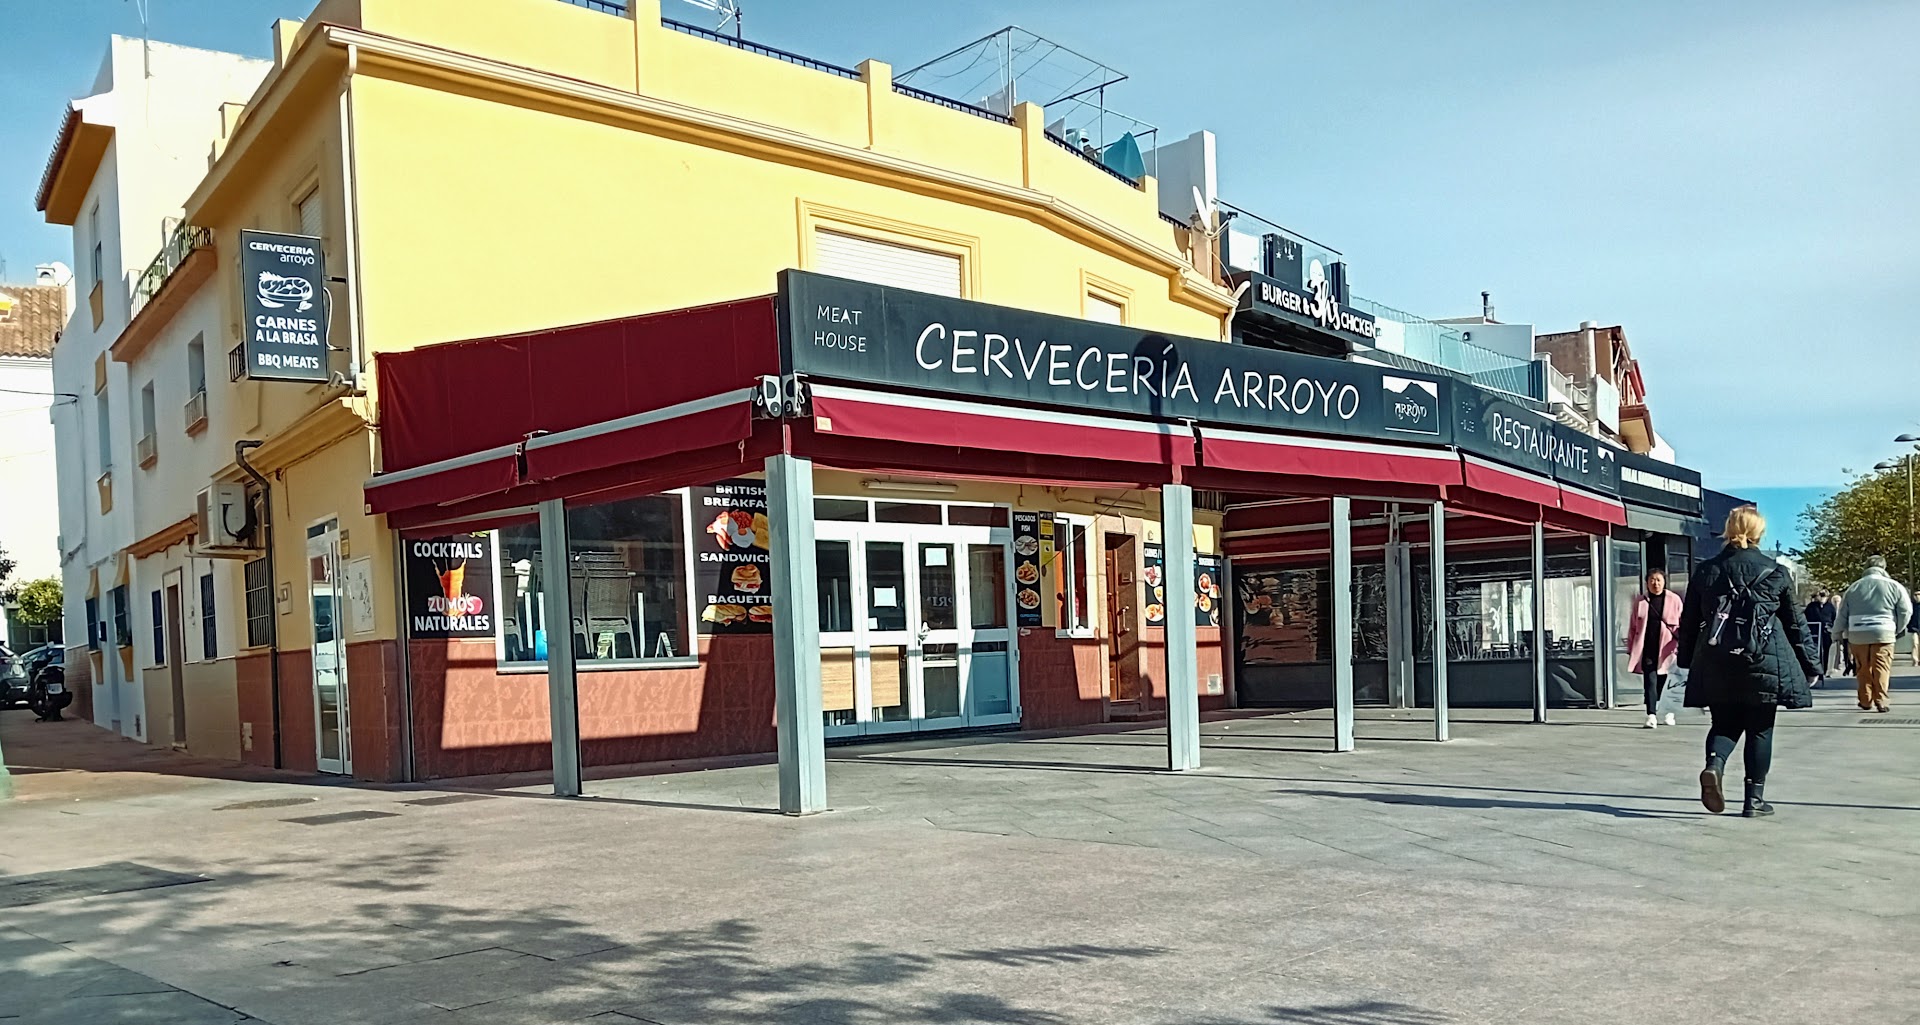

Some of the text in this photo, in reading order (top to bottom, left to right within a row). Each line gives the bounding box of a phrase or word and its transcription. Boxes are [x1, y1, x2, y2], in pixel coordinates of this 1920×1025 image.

[249, 241, 315, 256] CERVECERIA
[279, 253, 315, 267] arroyo
[816, 305, 862, 326] MEAT
[1262, 282, 1302, 313] BURGER
[1303, 297, 1311, 316] &
[1341, 312, 1376, 339] CHICKEN
[255, 315, 317, 332] CARNES
[255, 329, 319, 346] A LA BRASA
[814, 331, 868, 353] HOUSE
[258, 353, 319, 369] BBQ MEATS
[915, 322, 1360, 420] CERVECERÍA ARROYO
[1492, 412, 1589, 474] RESTAURANTE
[715, 485, 767, 496] BRITISH
[413, 541, 484, 559] COCKTAILS
[427, 597, 475, 612] ZUMOS
[414, 614, 490, 632] NATURALES
